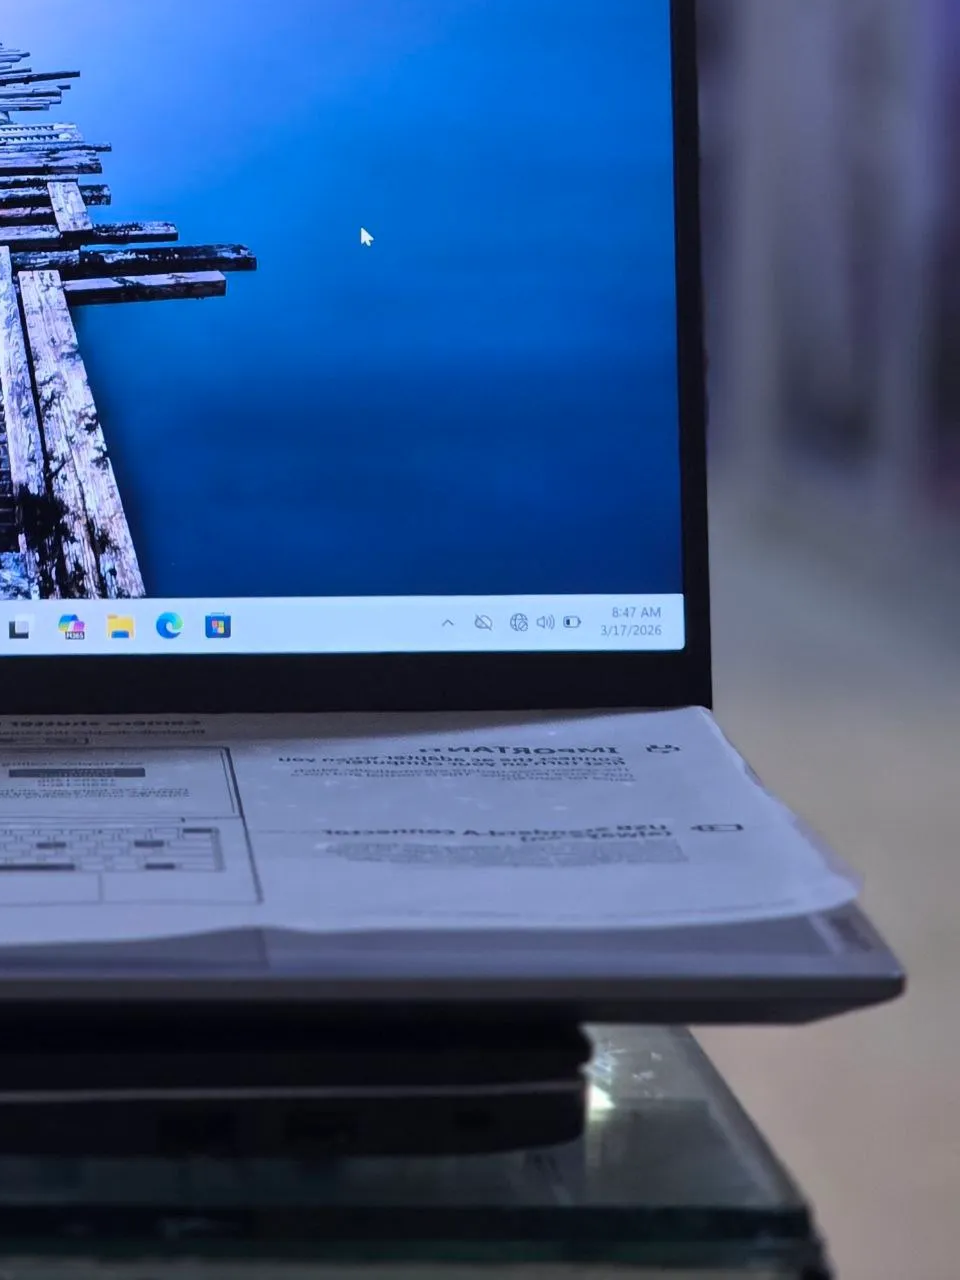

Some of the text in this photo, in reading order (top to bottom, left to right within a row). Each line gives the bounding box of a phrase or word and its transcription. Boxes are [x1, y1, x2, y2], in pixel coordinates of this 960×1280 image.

[612, 606, 661, 618] 8:47 AM
[601, 625, 662, 636] 3/17/2026
